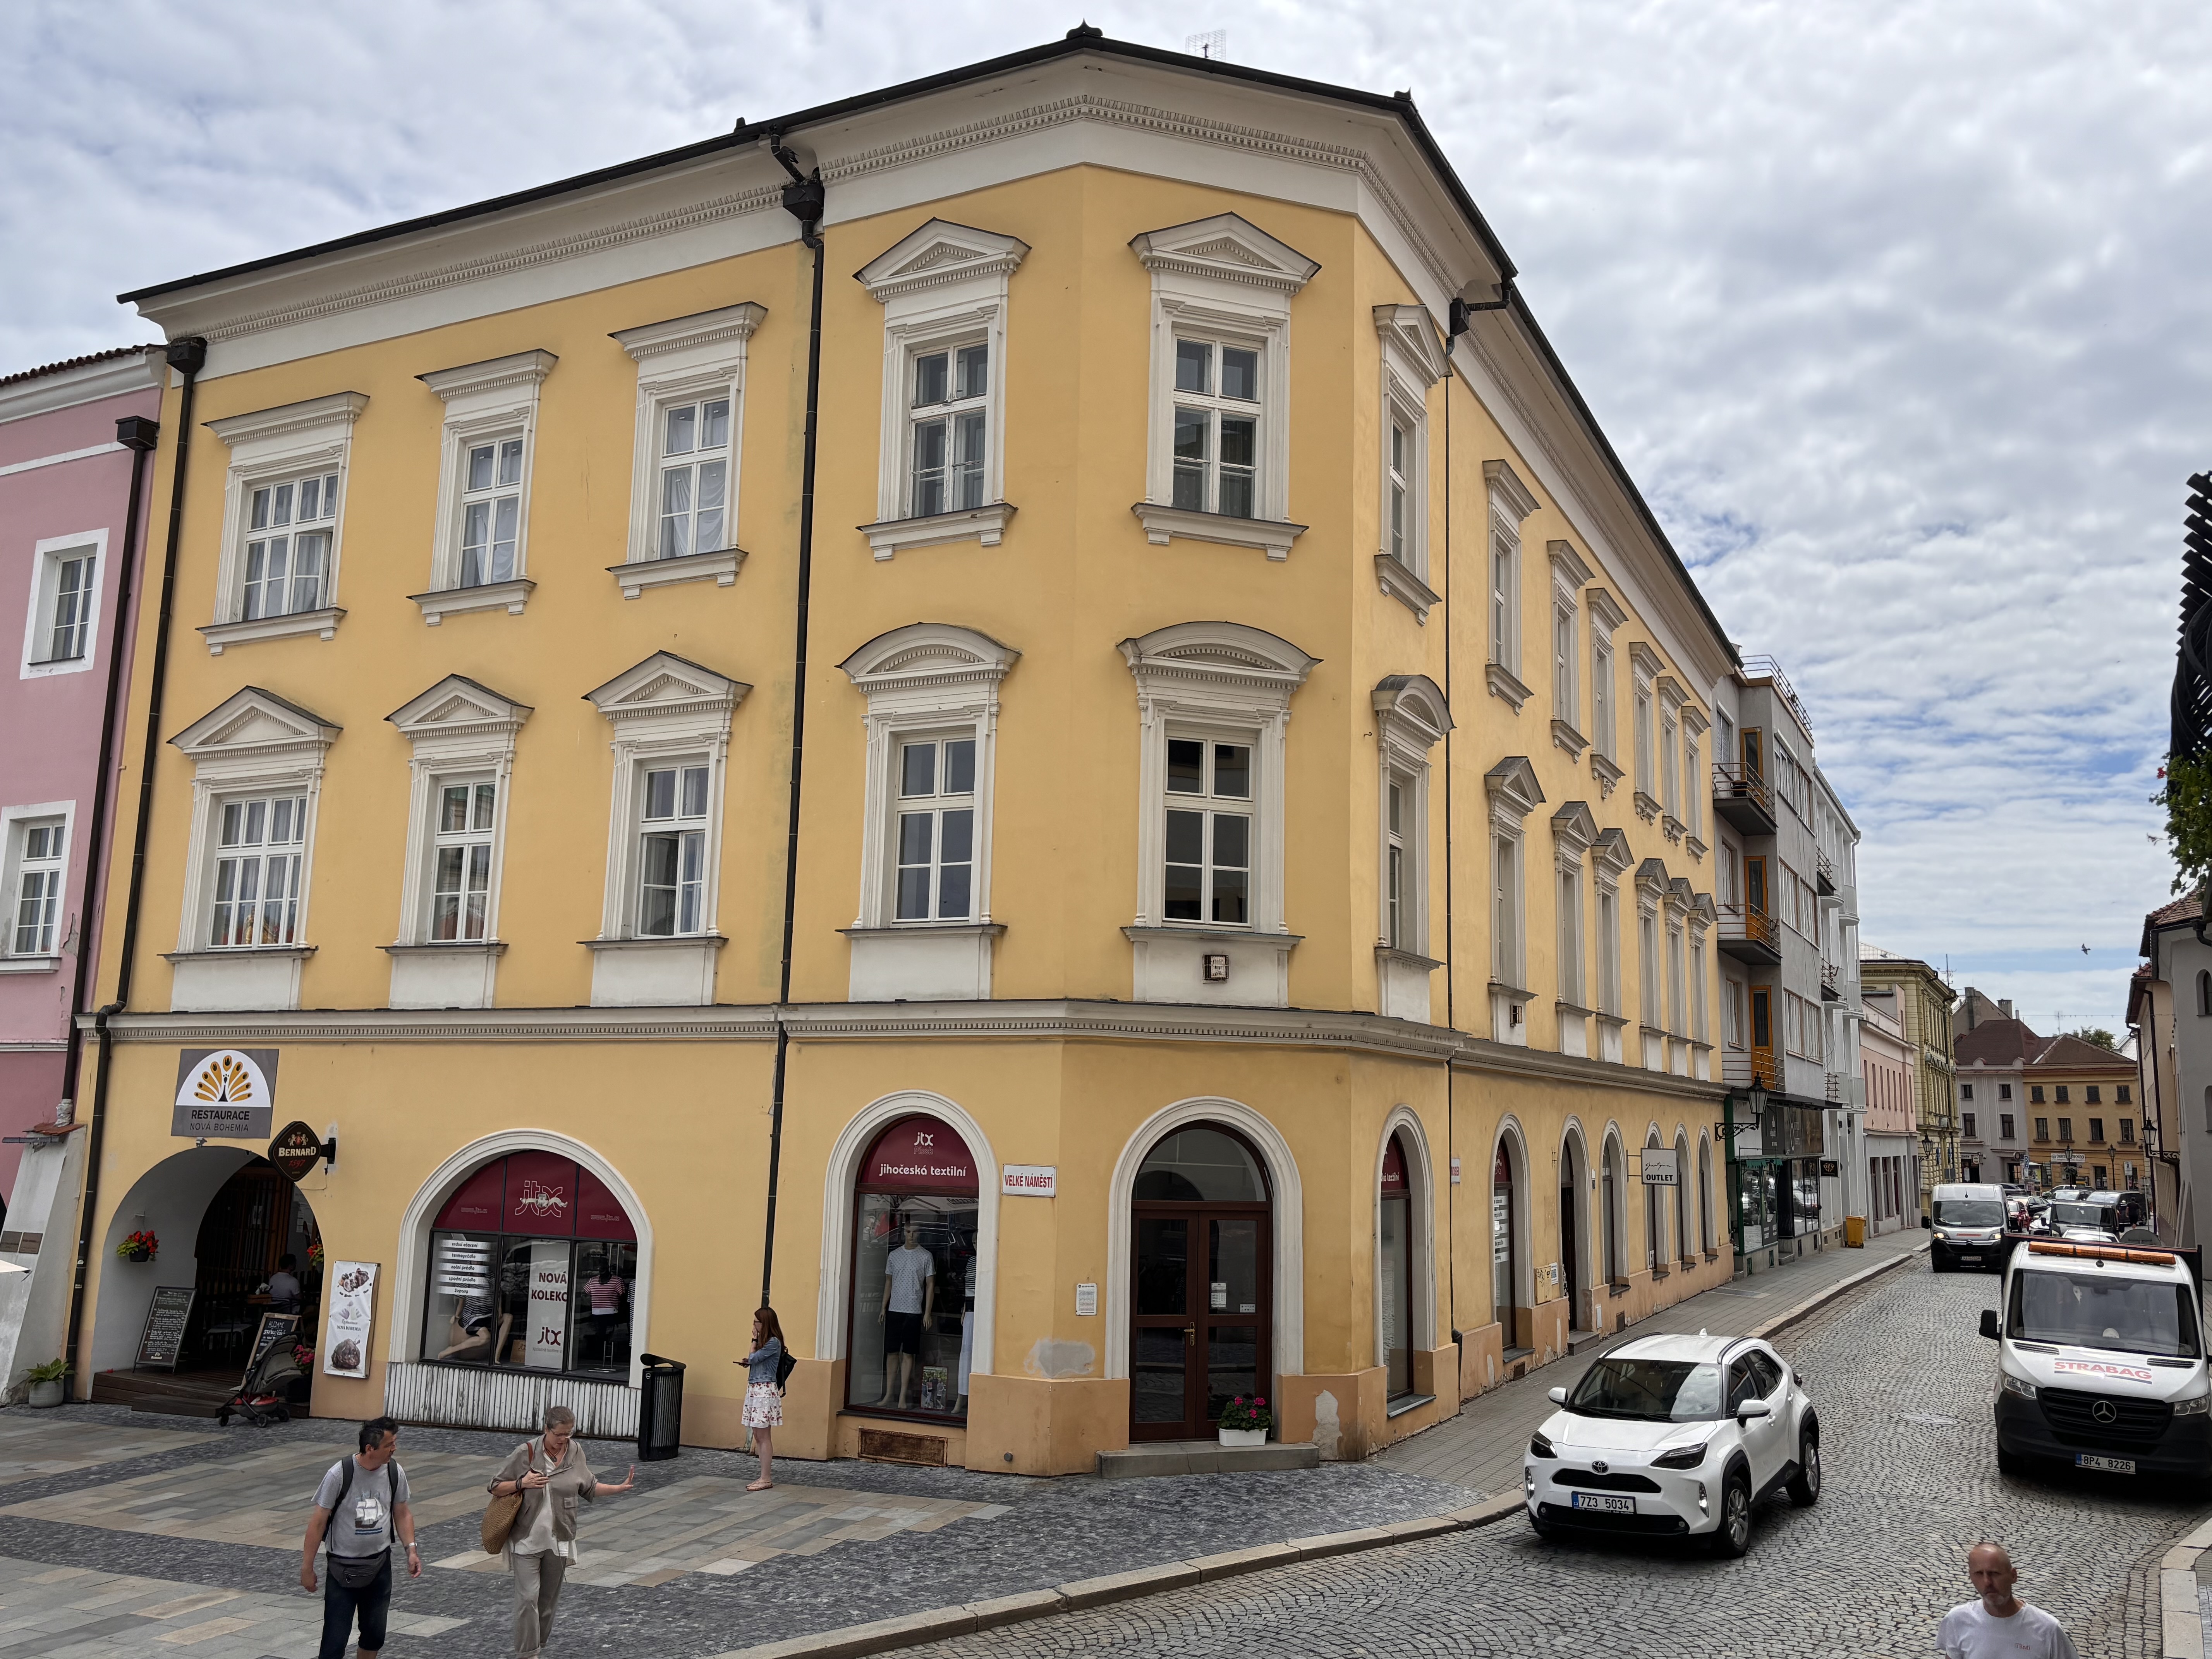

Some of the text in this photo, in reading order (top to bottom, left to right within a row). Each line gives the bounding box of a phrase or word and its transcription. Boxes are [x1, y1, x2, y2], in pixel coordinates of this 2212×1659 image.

[191, 1109, 250, 1120] RESTAURACE
[190, 1121, 249, 1132] NOVÁ BOHEMIA
[914, 1132, 934, 1146] jtx
[278, 1146, 316, 1157] BERNARD
[879, 1164, 967, 1176] jihočeská textilní
[1005, 1173, 1053, 1188] VELKÉ NÁMĚSTÍ
[539, 1271, 567, 1284] NOVÁ
[538, 1326, 562, 1346] jtx
[2054, 1362, 2152, 1379] STRABAG
[2083, 1456, 2131, 1470] 8P4 8226
[1580, 1496, 1598, 1508] 7Z3
[1605, 1498, 1629, 1510] 5034
